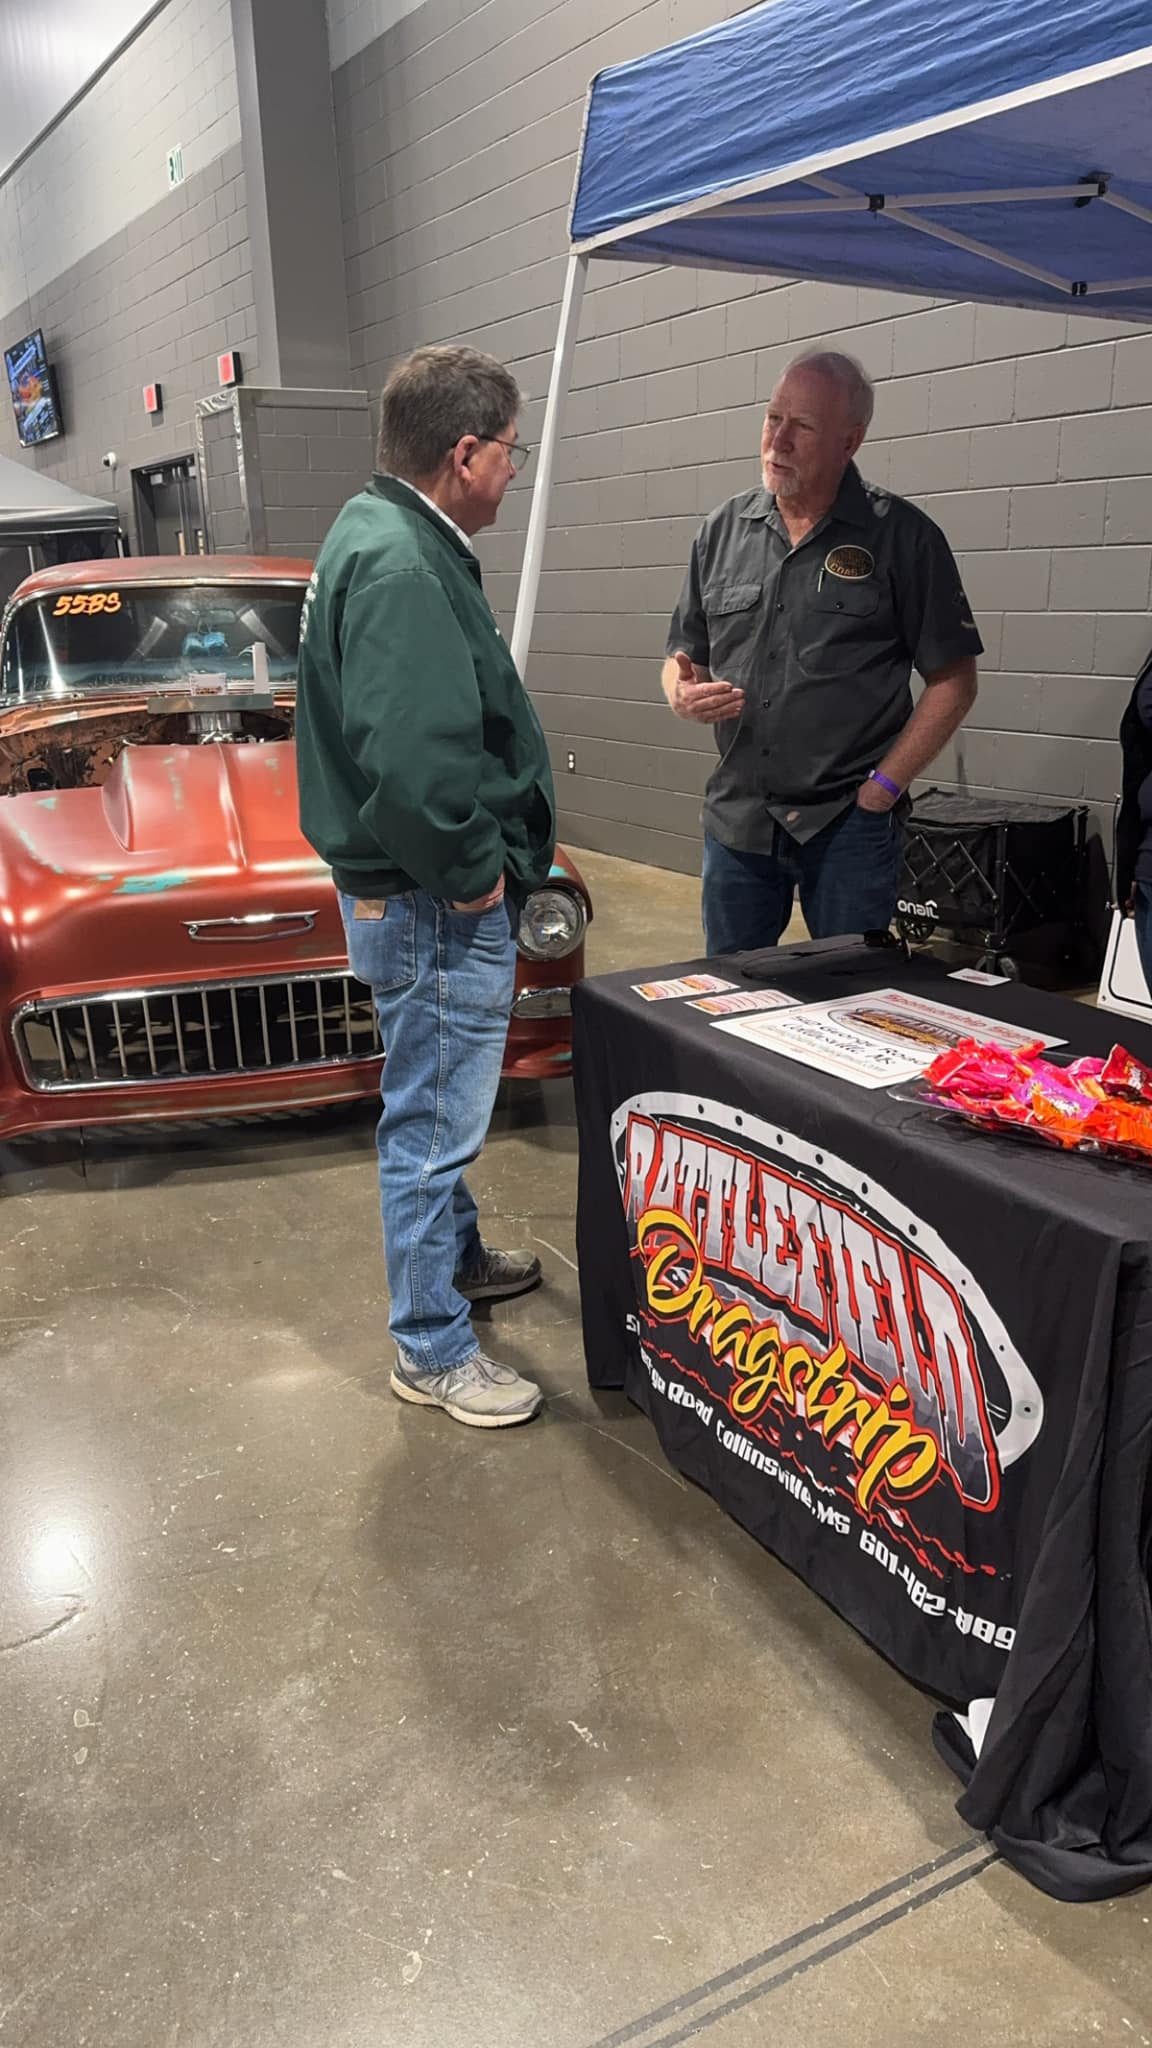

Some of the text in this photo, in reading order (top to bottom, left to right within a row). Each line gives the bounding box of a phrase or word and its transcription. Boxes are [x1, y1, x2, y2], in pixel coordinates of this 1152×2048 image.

[637, 1209, 937, 1511] Dragstrip
[668, 1381, 714, 1427] Road
[859, 1529, 1017, 1651] 601-482-889
